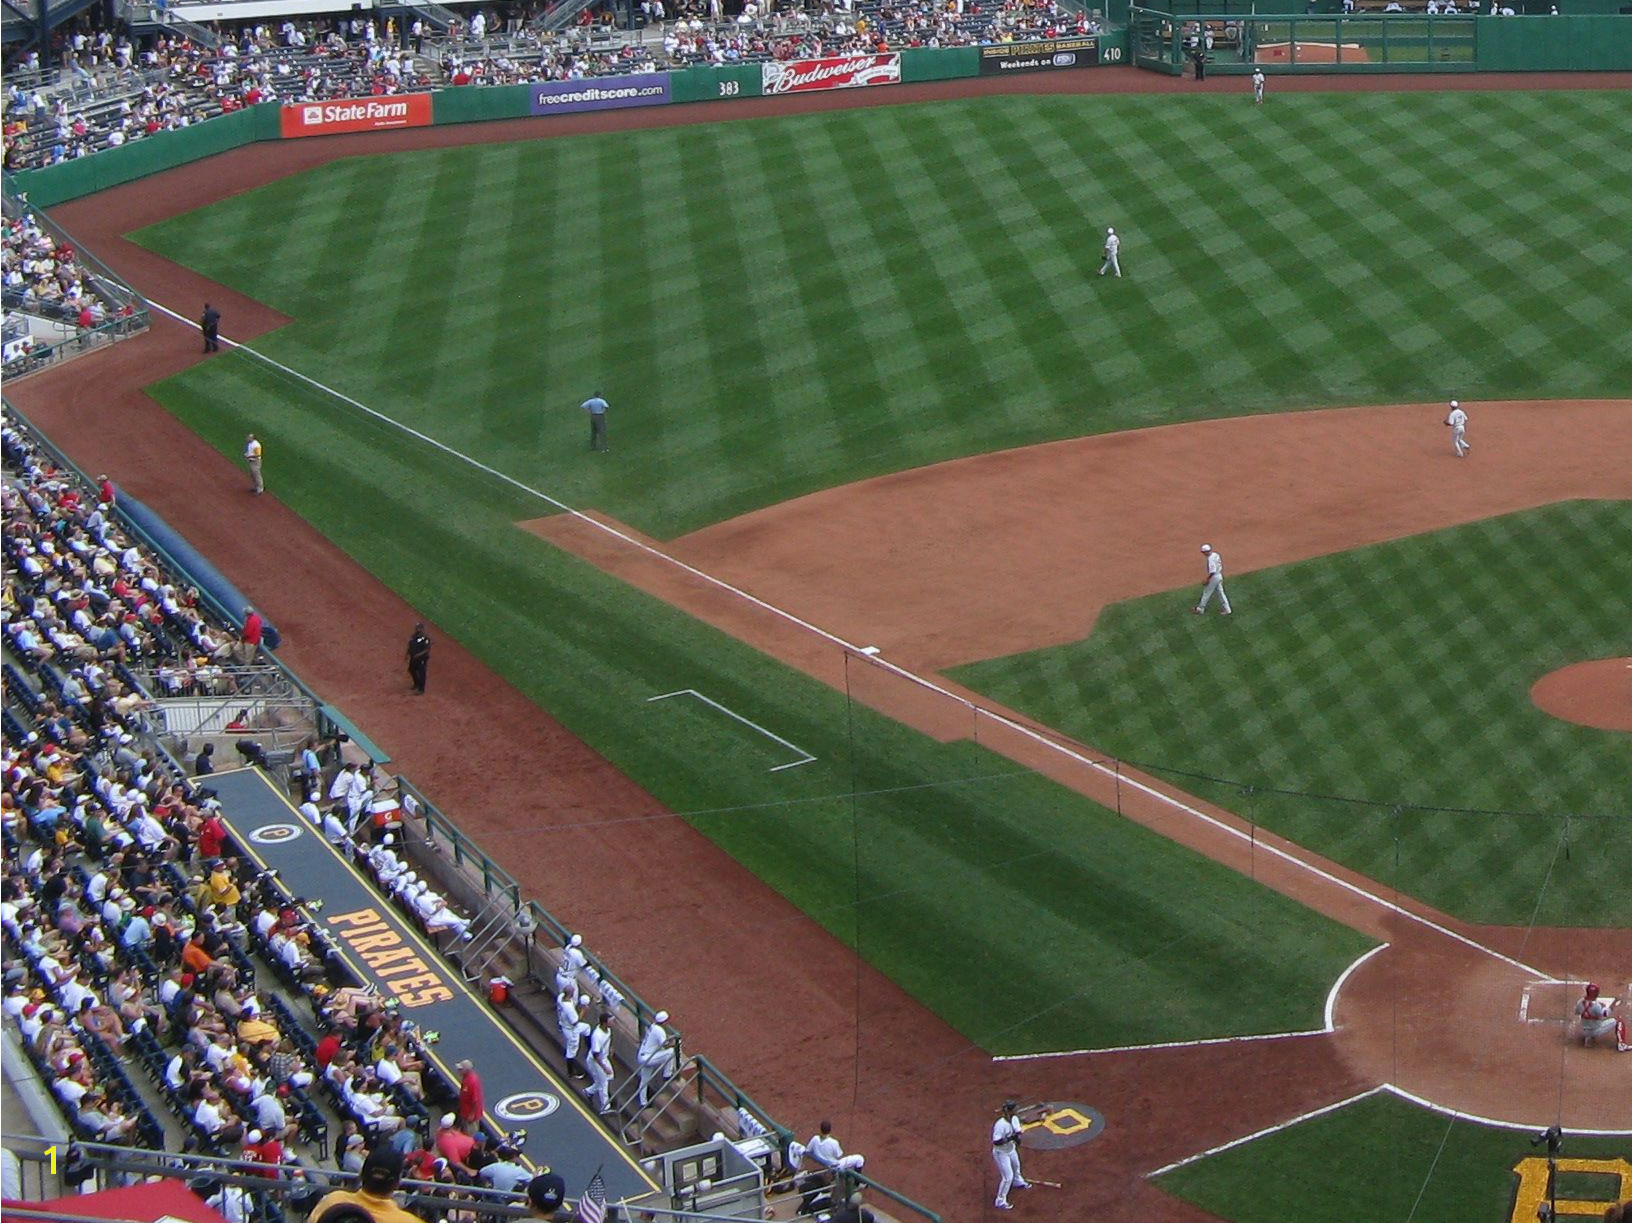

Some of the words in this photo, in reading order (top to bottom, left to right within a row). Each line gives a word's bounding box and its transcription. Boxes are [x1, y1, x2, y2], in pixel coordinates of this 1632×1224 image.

[1103, 47, 1122, 61] 410
[1000, 59, 1039, 69] Weekends
[1040, 58, 1051, 66] on
[773, 56, 876, 93] Budweiser
[539, 86, 663, 106] freecreditscore.com
[719, 80, 740, 96] 383
[328, 908, 454, 1009] PIRATES
